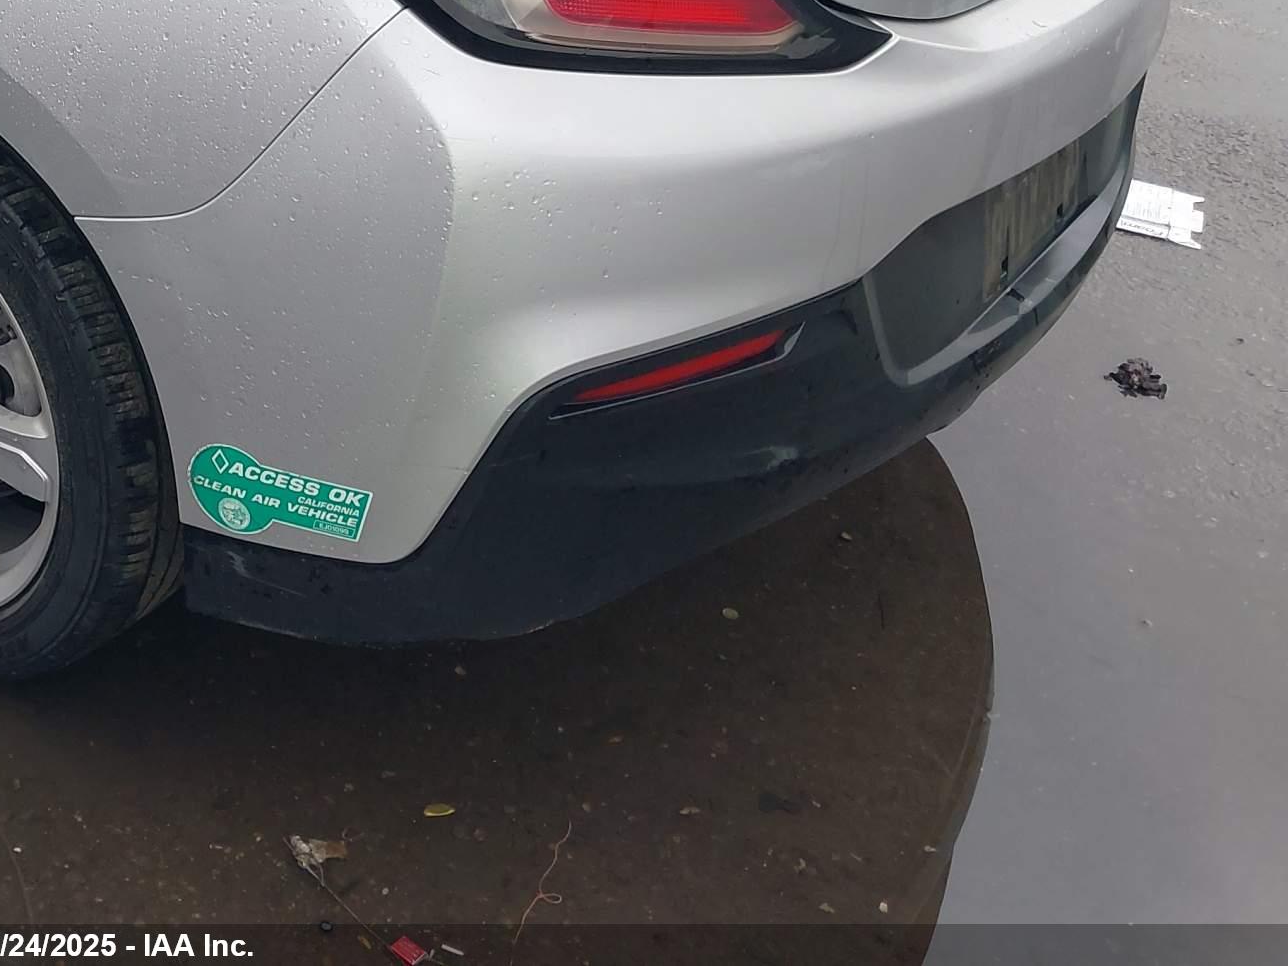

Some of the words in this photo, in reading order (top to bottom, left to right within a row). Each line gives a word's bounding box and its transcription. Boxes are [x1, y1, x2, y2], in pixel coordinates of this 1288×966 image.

[192, 475, 247, 499] CLEAN
[251, 493, 281, 509] AIR
[287, 502, 359, 528] VEHICLE
[228, 461, 321, 497] ACCESS
[328, 487, 365, 507] OK
[297, 495, 360, 518] CALIFORNIA
